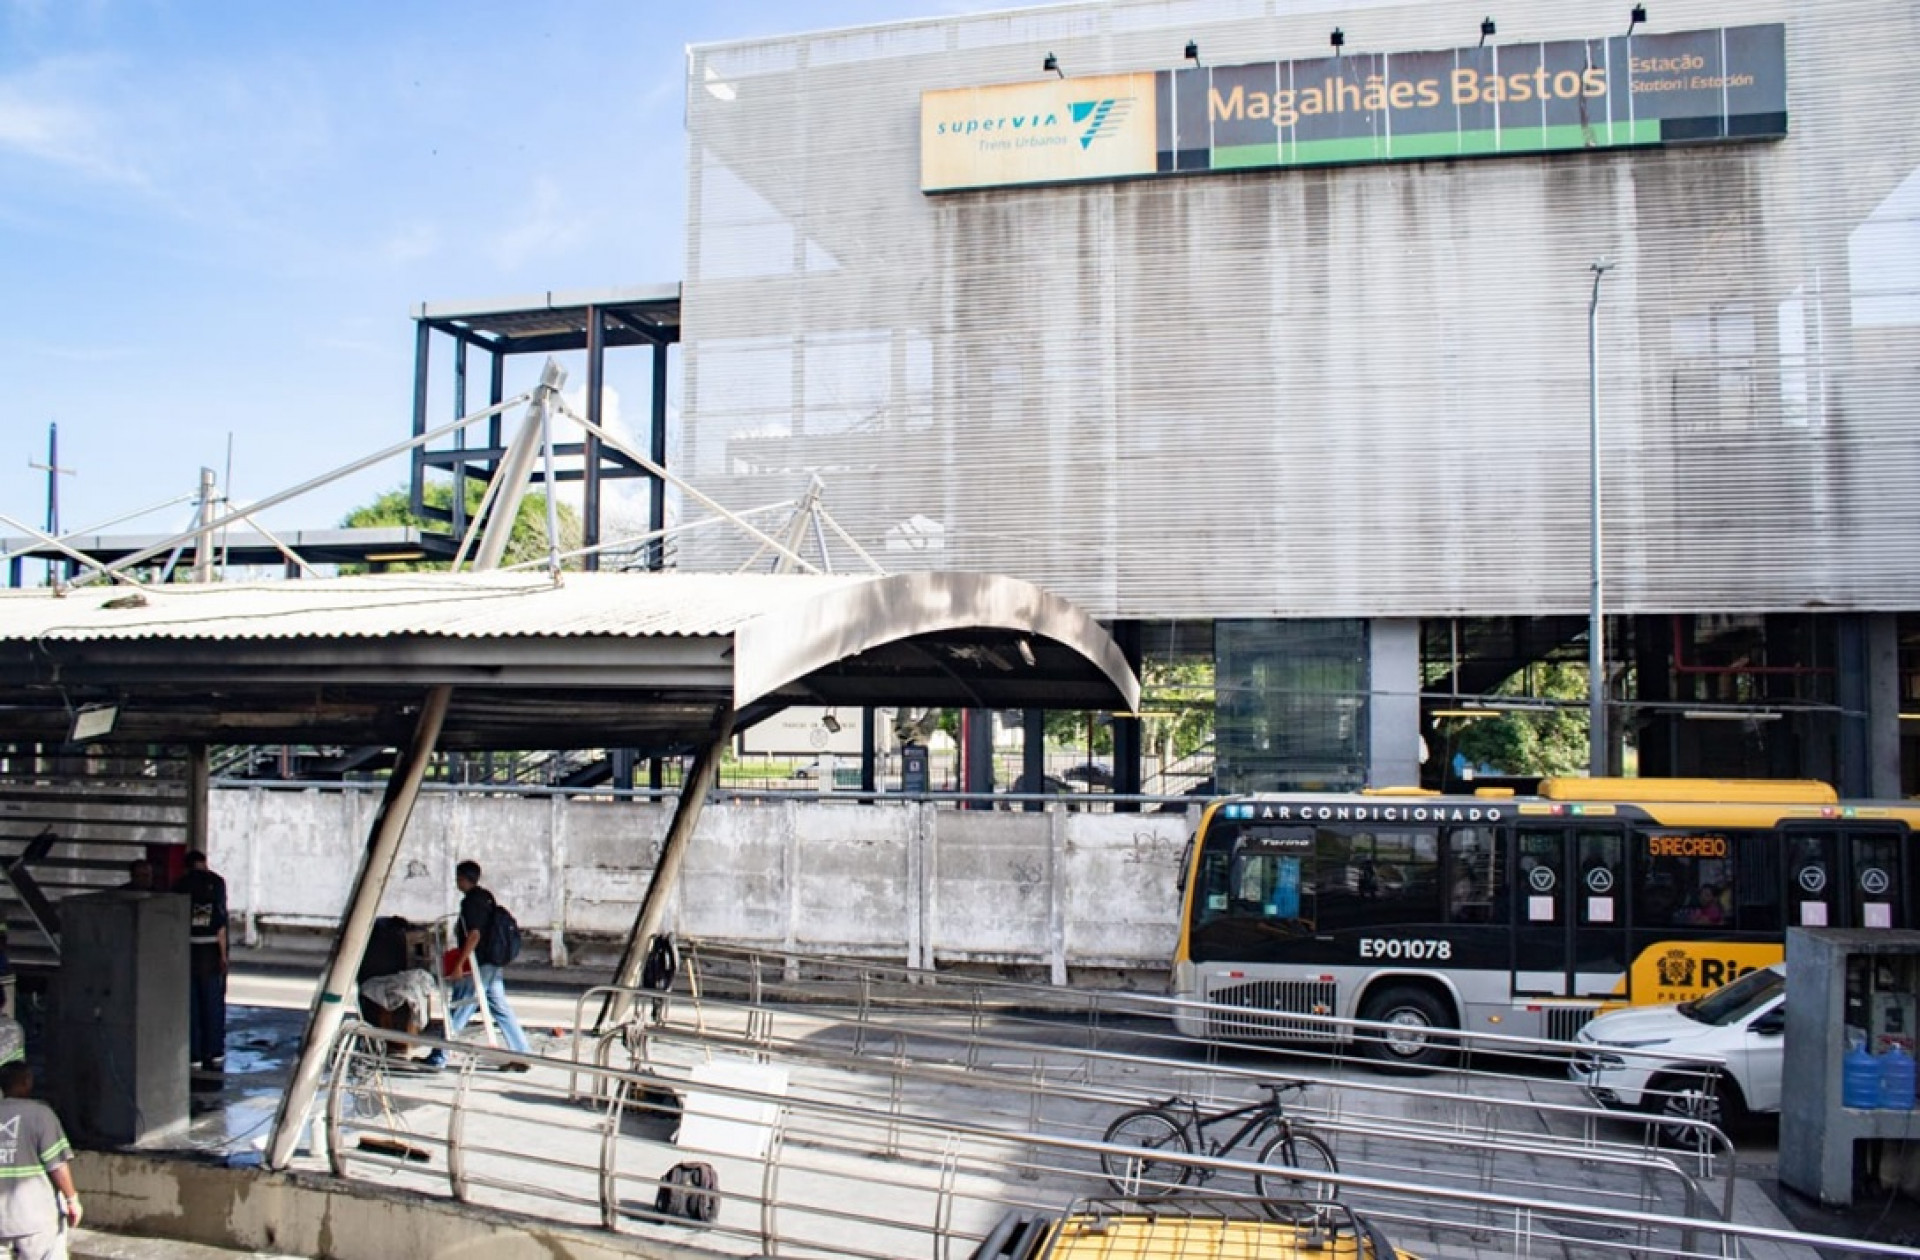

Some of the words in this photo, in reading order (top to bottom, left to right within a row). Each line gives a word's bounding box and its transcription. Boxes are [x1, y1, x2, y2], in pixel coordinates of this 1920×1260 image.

[1629, 54, 1703, 74] Estação
[1631, 78, 1682, 92] Station
[1207, 74, 1440, 127] Magalhães
[1451, 66, 1607, 105] Bastos
[979, 138, 1011, 151] Trens
[1015, 135, 1067, 148] Urbanos
[1262, 805, 1290, 820] AR
[1300, 805, 1501, 821] CONDICIONADO
[1360, 939, 1451, 959] E901078
